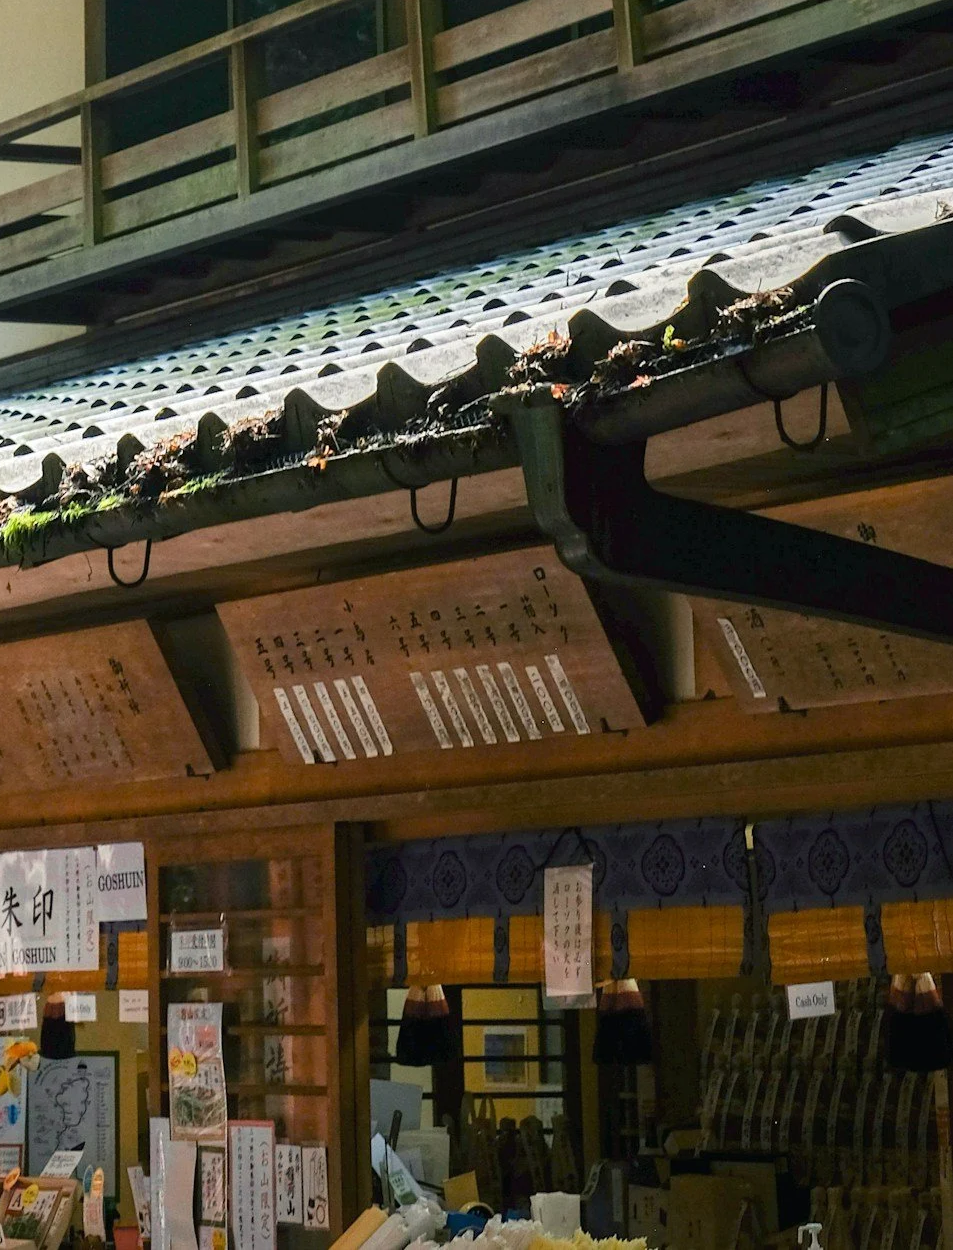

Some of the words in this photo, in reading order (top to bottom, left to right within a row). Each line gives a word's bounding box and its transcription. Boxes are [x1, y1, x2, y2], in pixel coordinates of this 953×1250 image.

[499, 603, 521, 642] 一号
[533, 567, 569, 643] ローソク
[343, 599, 375, 666] 小鳥居
[389, 615, 410, 657] 六号
[409, 611, 430, 653] 五号
[430, 609, 451, 650] 四号
[454, 606, 476, 648] 三号
[475, 604, 497, 647] 二号
[255, 637, 276, 679] 五号
[273, 635, 294, 674] 四号
[293, 631, 313, 670] 三号
[314, 629, 335, 668] 二号
[334, 628, 355, 666] 一号
[98, 870, 144, 892] GOSHUIN
[563, 883, 571, 979] ローソクの火を
[12, 947, 57, 965] GOSHUIN
[795, 995, 812, 1007] Cash
[813, 993, 828, 1007] Only
[12, 1193, 21, 1207] A
